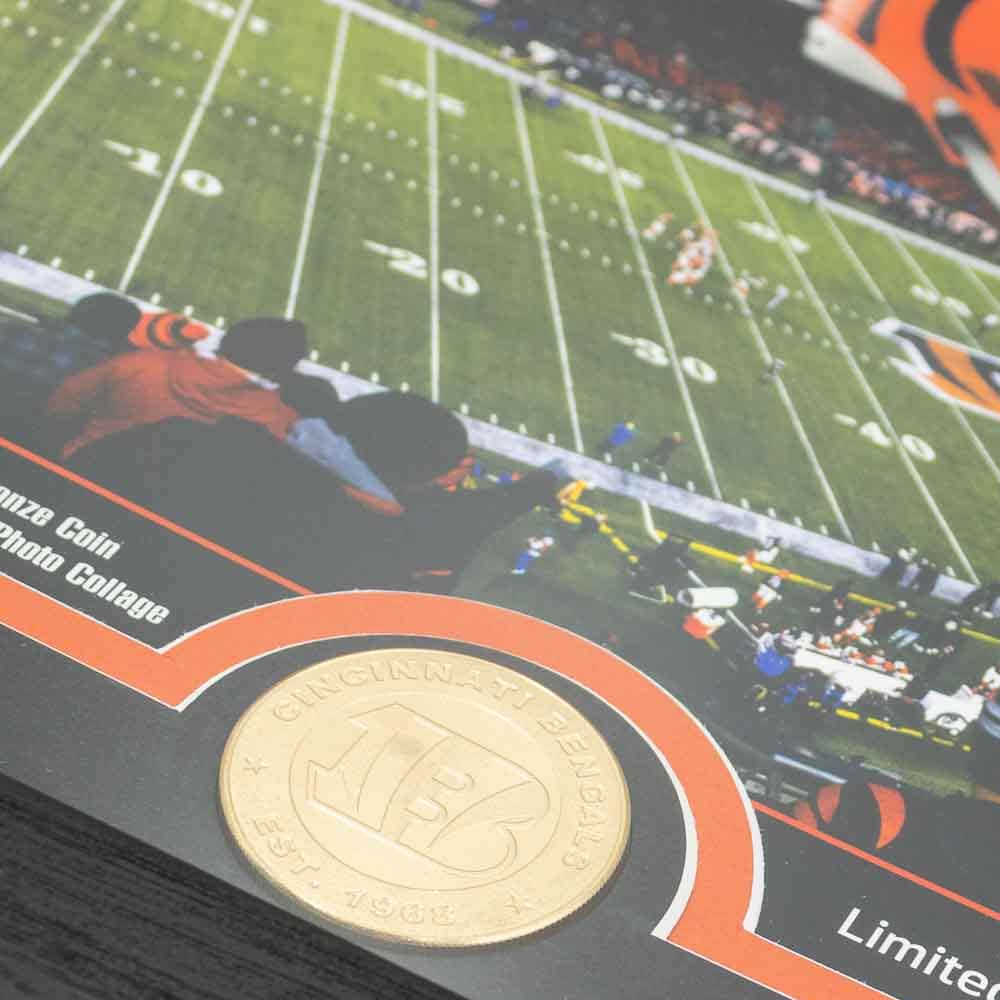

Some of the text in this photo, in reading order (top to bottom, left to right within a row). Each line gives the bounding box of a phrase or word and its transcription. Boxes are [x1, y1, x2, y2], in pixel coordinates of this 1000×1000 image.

[129, 147, 223, 197] 10
[388, 248, 479, 295] 20
[55, 517, 121, 560] Coin
[65, 562, 170, 624] Collage
[273, 660, 607, 870] CINCINNATI BENGALS
[345, 888, 456, 925] 1968
